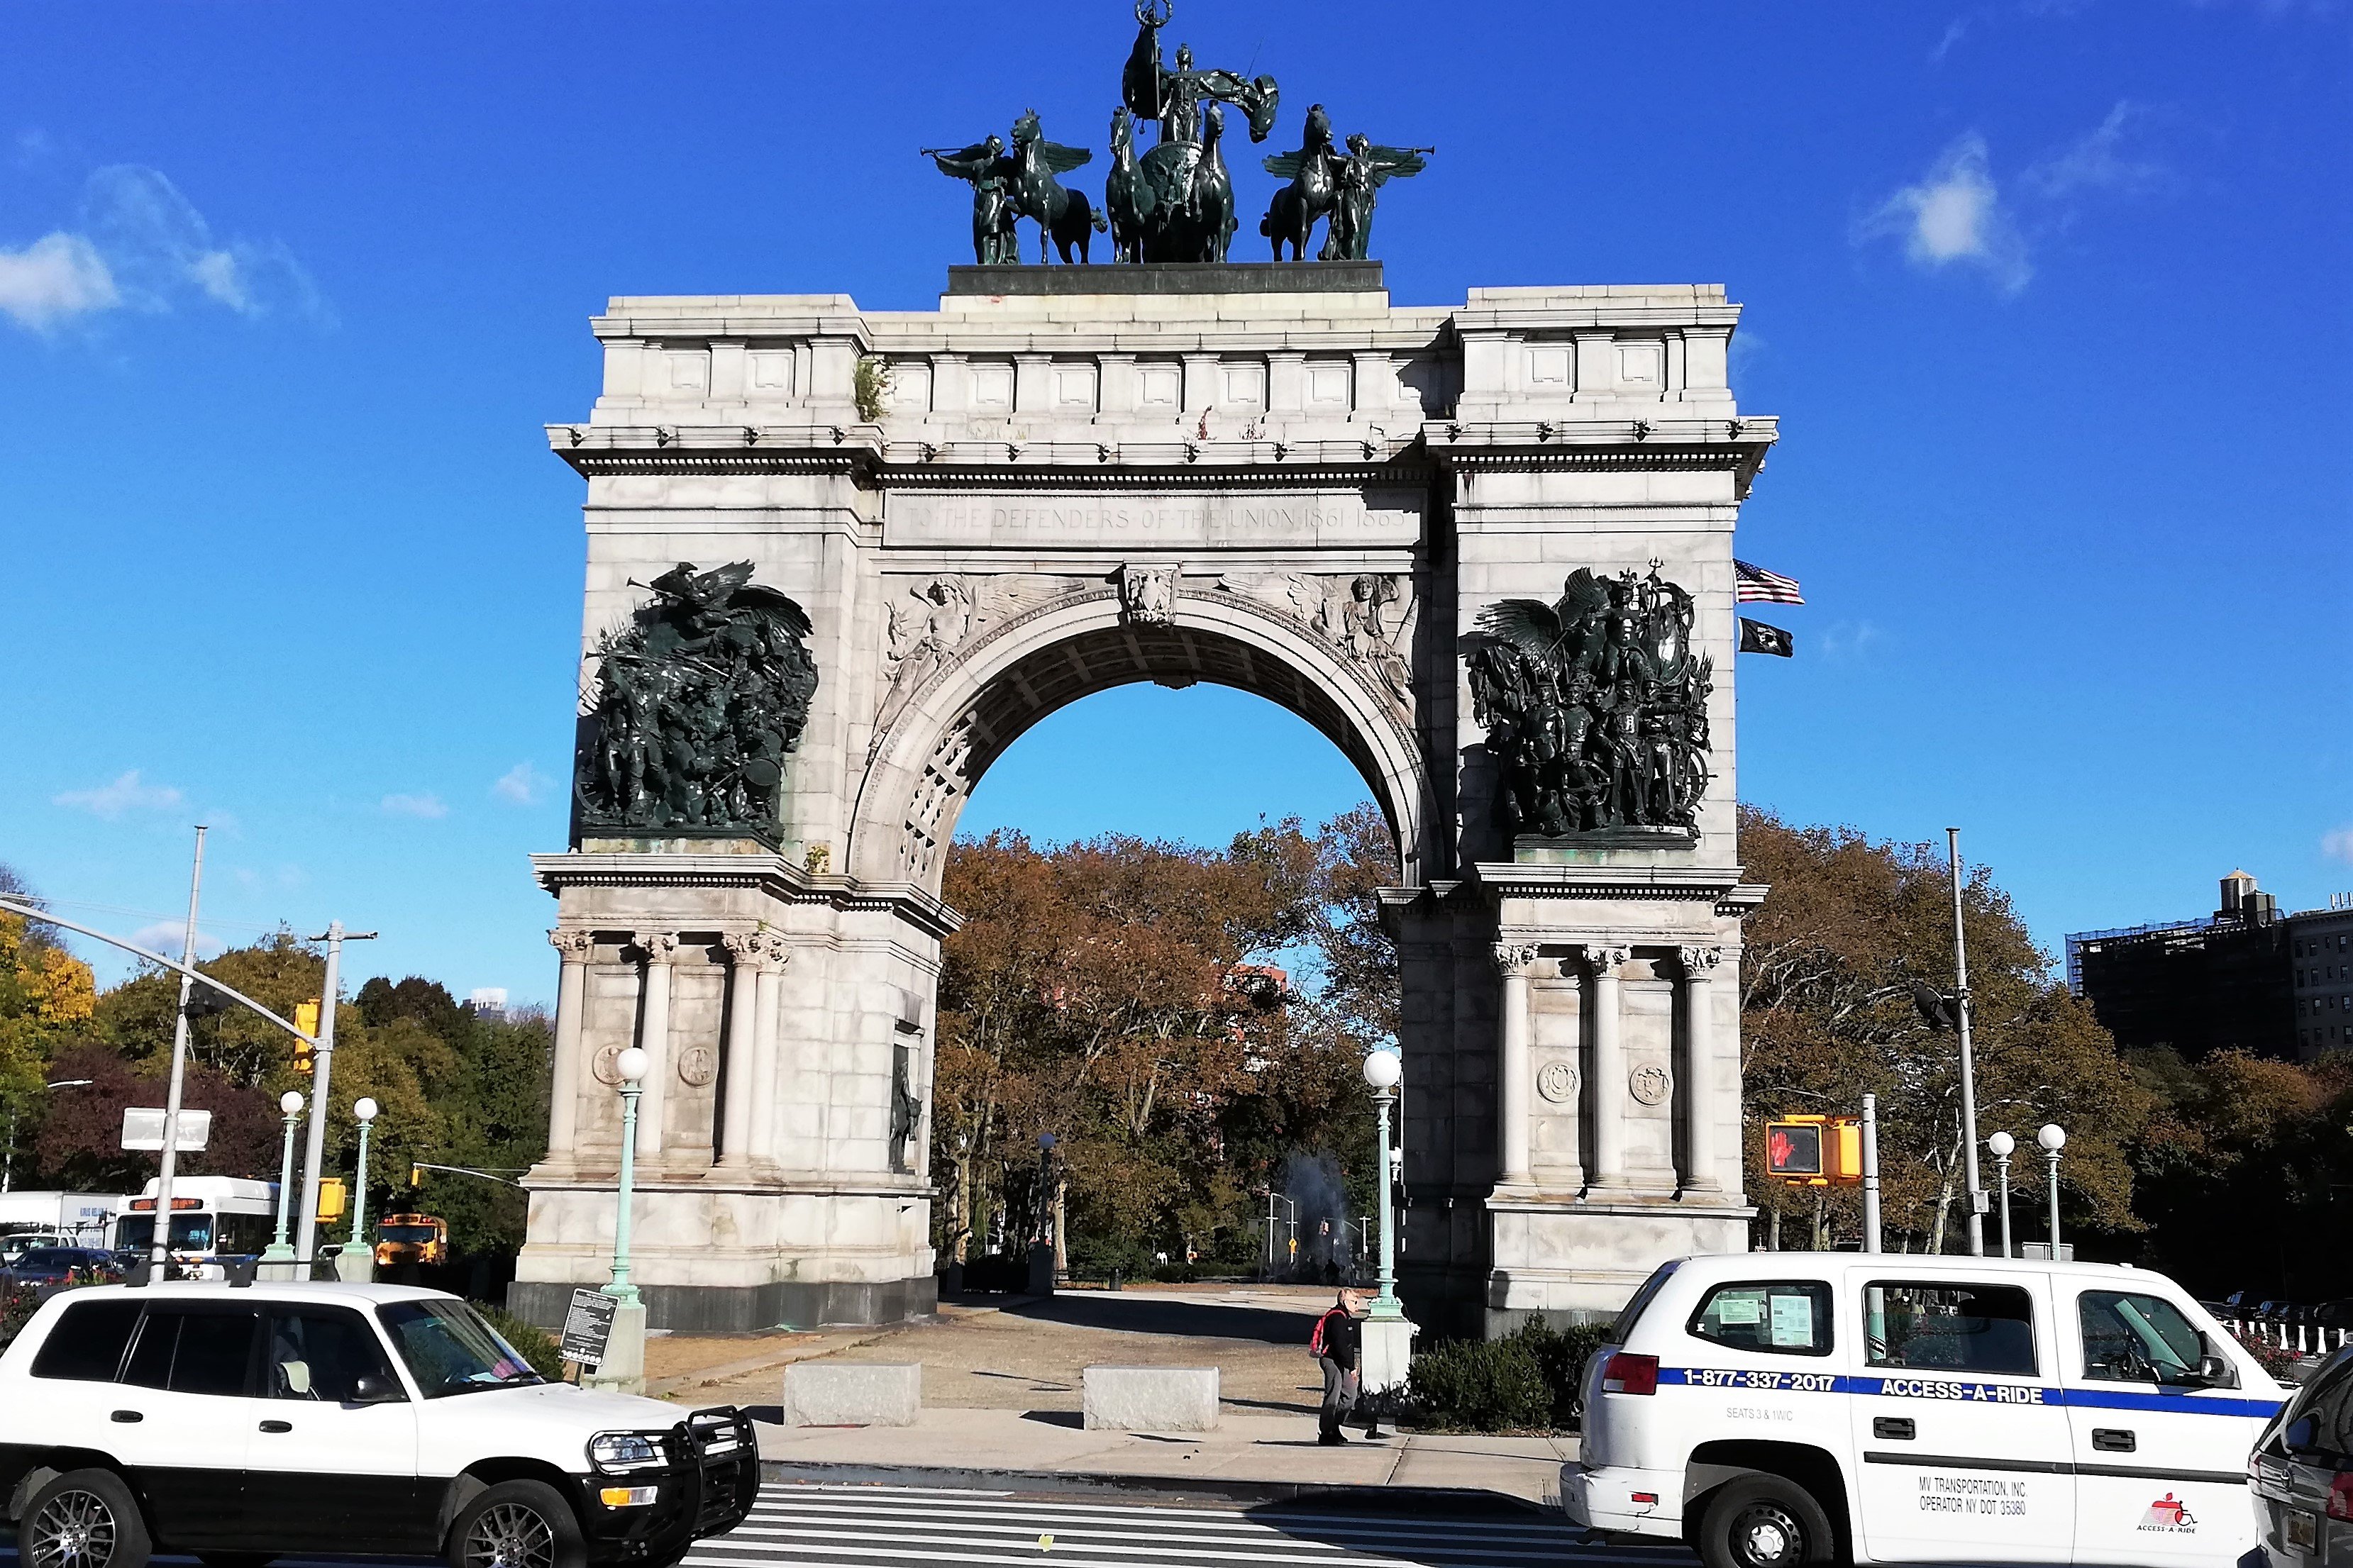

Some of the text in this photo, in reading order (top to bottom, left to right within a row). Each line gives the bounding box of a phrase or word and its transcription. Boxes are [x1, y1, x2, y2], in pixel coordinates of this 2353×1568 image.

[906, 508, 931, 528] TO
[942, 508, 983, 528] THE
[992, 508, 1129, 529] DEFENDERS
[1141, 508, 1170, 529] OF
[1177, 508, 1222, 529] THE
[1229, 508, 1295, 529] UNION
[1305, 508, 1344, 528] 1861
[1683, 1369, 1836, 1391] 1-877-337-2017
[1881, 1379, 2044, 1404] ACCESS-A-RIDE
[1727, 1407, 1754, 1419] SEATS
[1756, 1408, 1762, 1419] 3
[1764, 1409, 1770, 1420] &
[1919, 1477, 2028, 1498] MV TRANSPORTATION, INC.
[1920, 1496, 2026, 1516] OPERATOR NY DOT 35380
[2136, 1525, 2196, 1534] ACCESS-A-RIDE
